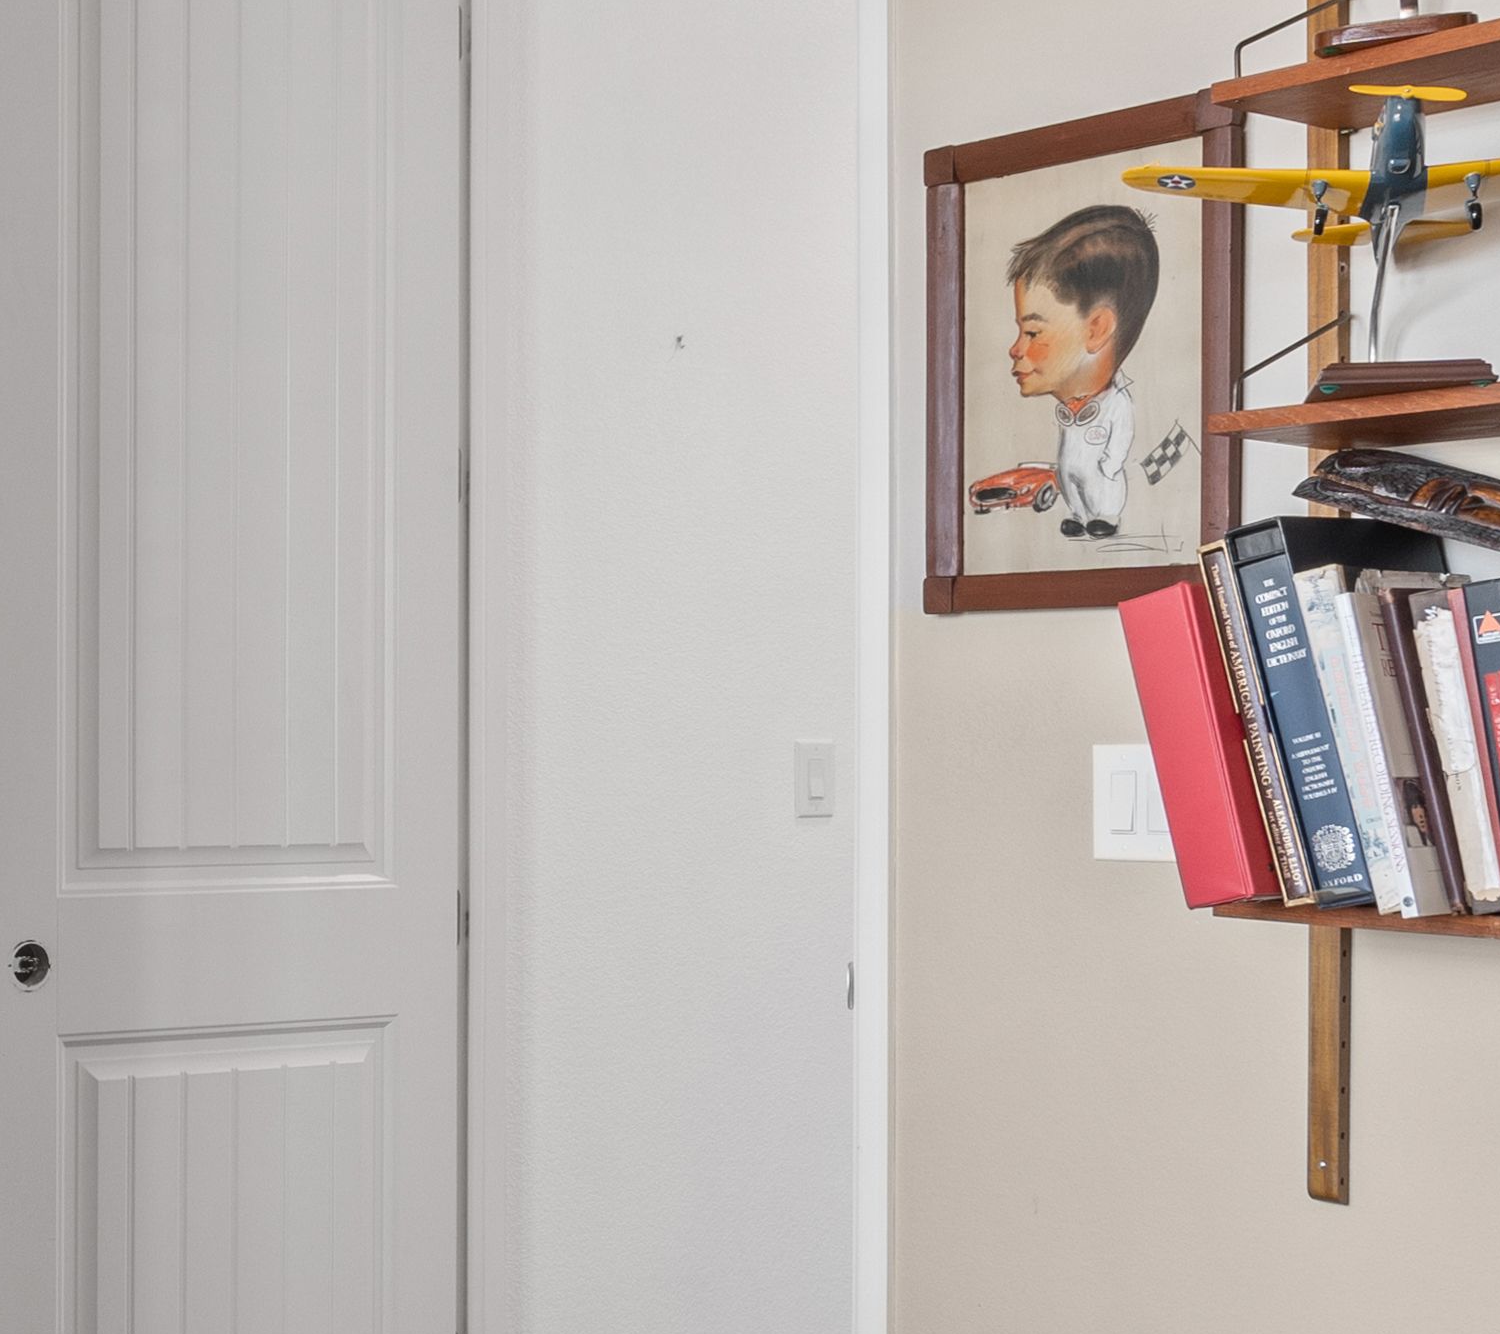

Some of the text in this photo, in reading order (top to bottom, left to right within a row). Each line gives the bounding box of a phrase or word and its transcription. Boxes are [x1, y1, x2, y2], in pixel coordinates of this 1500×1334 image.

[1216, 587, 1229, 618] Hundred
[1229, 649, 1255, 719] AMERICAN
[1247, 722, 1272, 786] PAINTING
[1272, 797, 1294, 856] ALEXANDER
[1287, 856, 1302, 887] ELIOT
[1321, 873, 1363, 887] OXFORD
